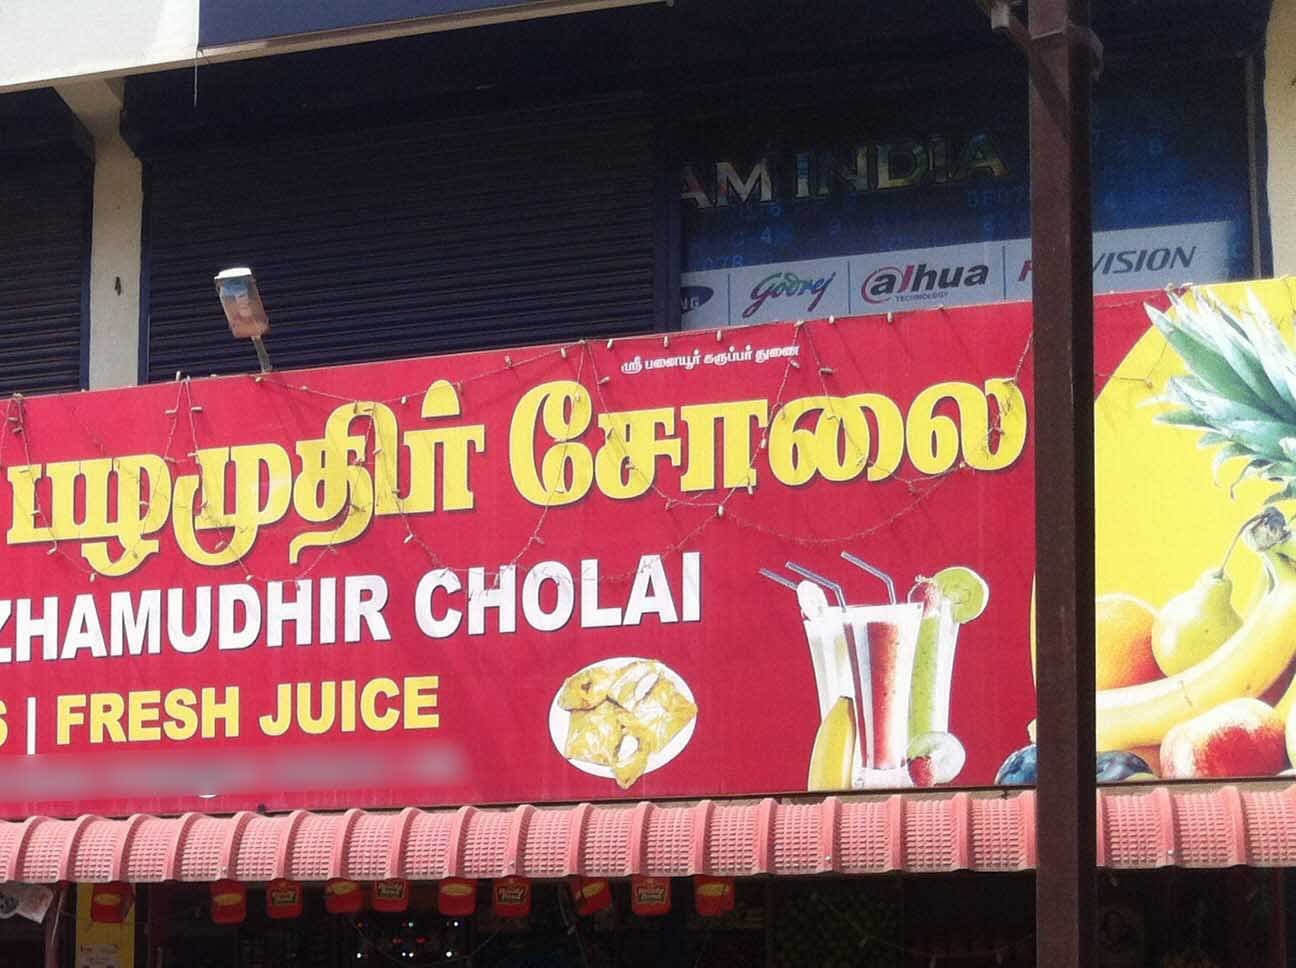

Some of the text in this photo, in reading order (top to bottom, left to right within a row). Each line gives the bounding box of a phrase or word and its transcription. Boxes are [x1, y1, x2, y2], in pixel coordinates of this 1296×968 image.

[741, 272, 837, 318] Godrej
[6, 379, 486, 577] பழமுதிர்
[509, 377, 1028, 507] சோலை
[414, 551, 702, 640] CHOLAI
[56, 686, 241, 745] FRESH
[259, 675, 440, 736] JUICE
